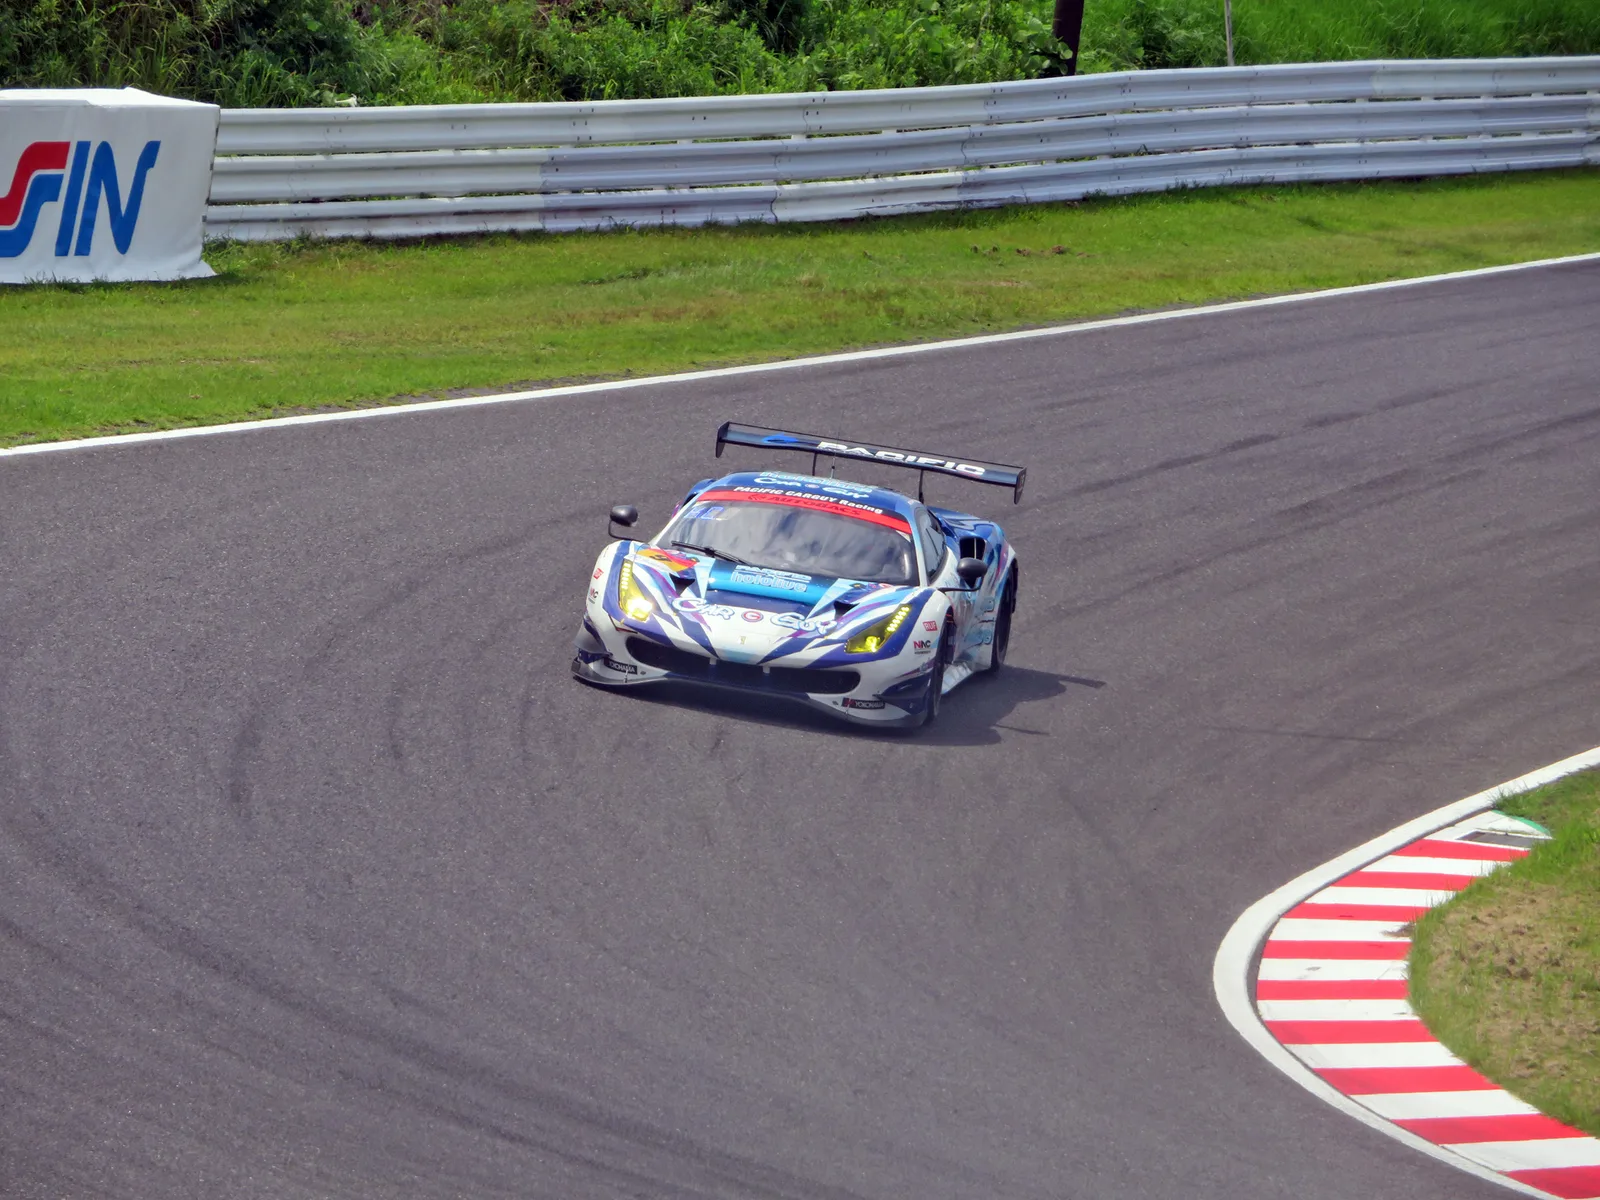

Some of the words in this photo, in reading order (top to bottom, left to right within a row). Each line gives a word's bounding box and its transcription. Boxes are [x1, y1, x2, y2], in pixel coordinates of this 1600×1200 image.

[815, 440, 986, 477] PACIFIC
[733, 486, 784, 495] PACIFIC
[785, 490, 838, 503] CARGUY
[838, 499, 884, 514] Racing
[913, 640, 931, 649] NAC
